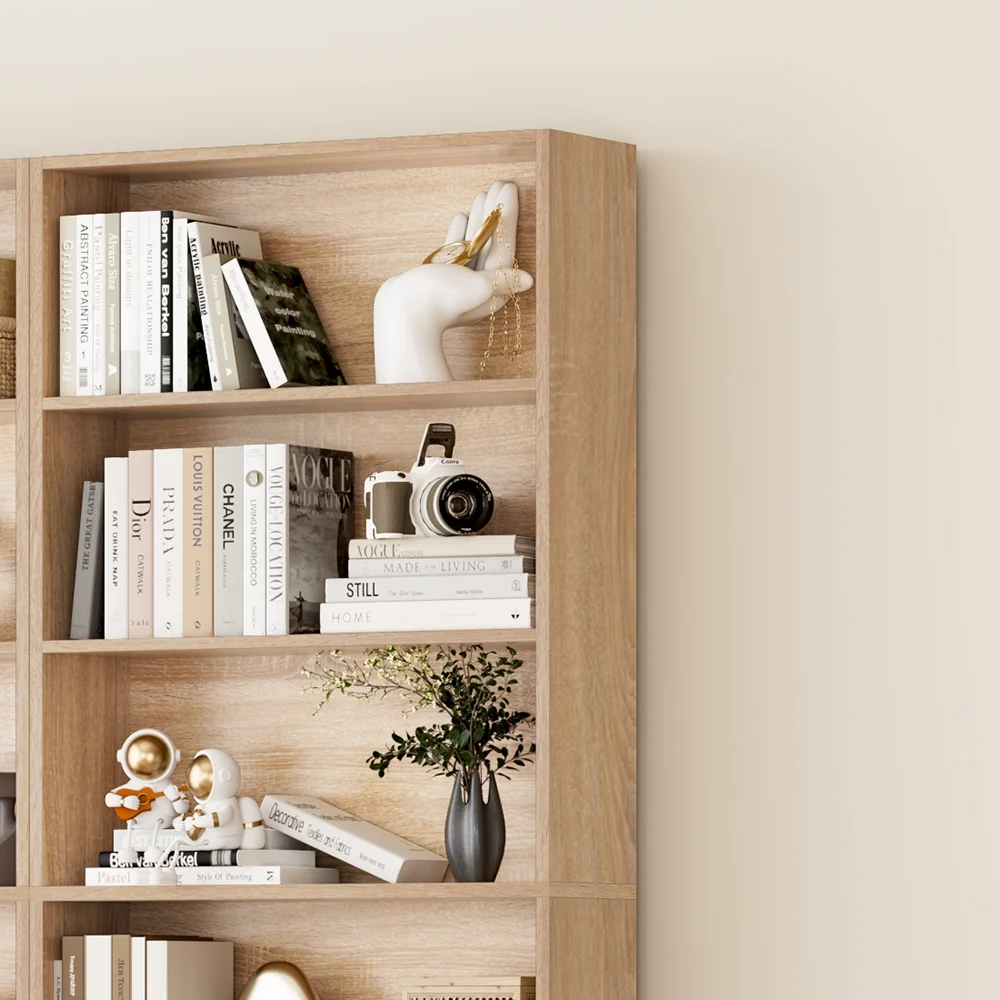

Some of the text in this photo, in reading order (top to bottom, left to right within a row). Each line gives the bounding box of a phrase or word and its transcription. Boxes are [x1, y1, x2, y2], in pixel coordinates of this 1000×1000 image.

[93, 225, 103, 265] Pastel
[161, 248, 170, 278] van
[62, 240, 74, 332] Graffiti Art
[80, 224, 89, 344] ABSTRACT PAINTING
[108, 270, 118, 290] Siza
[124, 230, 133, 306] Light in design
[274, 307, 301, 317] color
[274, 323, 316, 338] Painting
[193, 455, 203, 492] LOUIS
[162, 487, 176, 554] PRADA
[193, 493, 203, 548] VUITTON
[222, 483, 235, 550] CHANEL
[250, 527, 257, 535] IN
[81, 518, 93, 571] THE GREAT
[131, 497, 152, 594] Dior CATWALK
[269, 522, 283, 603] LOCATION
[356, 544, 401, 557] VOGUE
[383, 560, 420, 573] MADE
[440, 560, 486, 573] LIVING
[346, 582, 379, 598] STILL
[332, 611, 372, 623] HOME
[97, 871, 130, 883] Pastel
